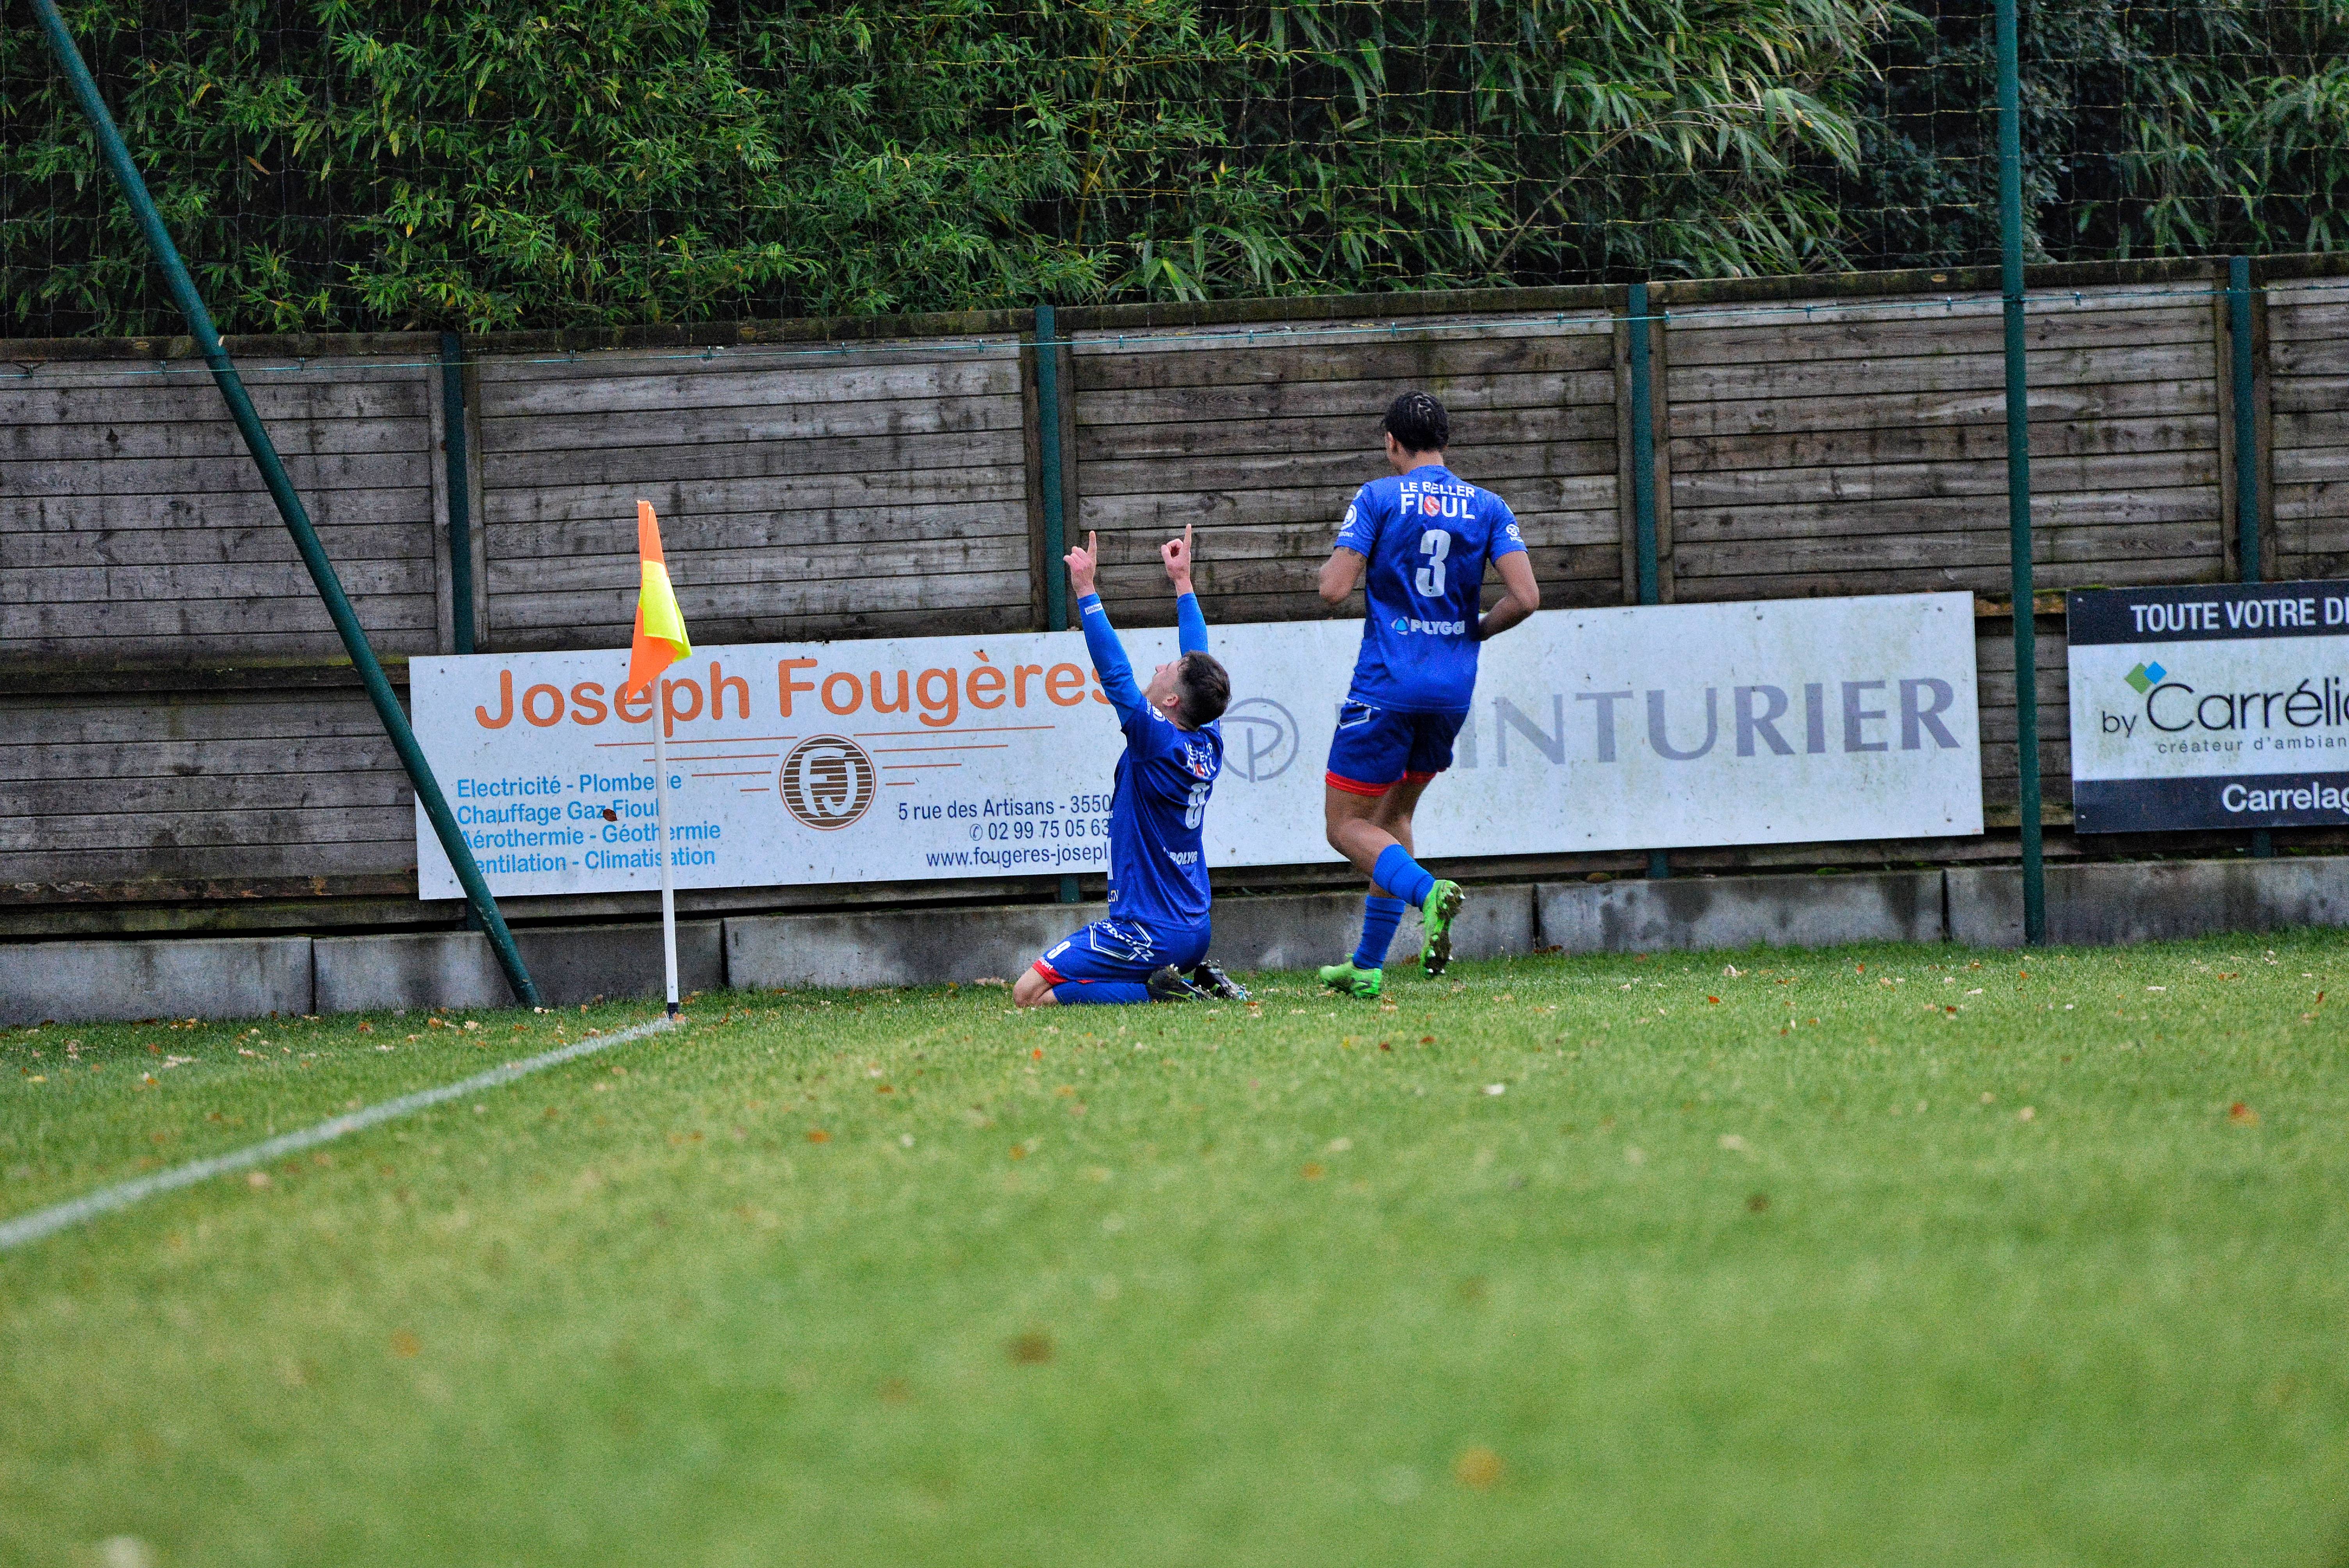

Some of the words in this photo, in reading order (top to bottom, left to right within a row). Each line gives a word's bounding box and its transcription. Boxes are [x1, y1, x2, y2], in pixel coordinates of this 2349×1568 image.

[1400, 482, 1418, 493] LE
[1422, 481, 1476, 498] BELLER
[1401, 493, 1476, 520] FIOUL
[1415, 529, 1451, 597] 3
[2130, 602, 2220, 633] TOUTE
[2225, 597, 2316, 629] VOTRE
[475, 661, 750, 738] Joseph
[2102, 711, 2137, 738] by
[2147, 677, 2349, 732] Carréli
[1327, 678, 1960, 768] INTURIER
[2158, 739, 2243, 754] créateur
[457, 775, 561, 798] Electricité
[579, 771, 681, 793] Plombeie
[457, 803, 561, 826] Chauffage
[567, 800, 606, 820] Gaz
[613, 798, 659, 818] Fioul
[899, 802, 908, 820] 5
[914, 805, 942, 820] rue
[947, 800, 977, 818] des
[984, 798, 1054, 817] Artisans
[989, 822, 1009, 840] 02
[1014, 821, 1034, 839] 99
[1040, 820, 1059, 838] 75
[1065, 820, 1085, 837] 05
[1091, 818, 1109, 836] 63
[475, 853, 566, 873] entilation
[585, 846, 716, 870] Climatisation
